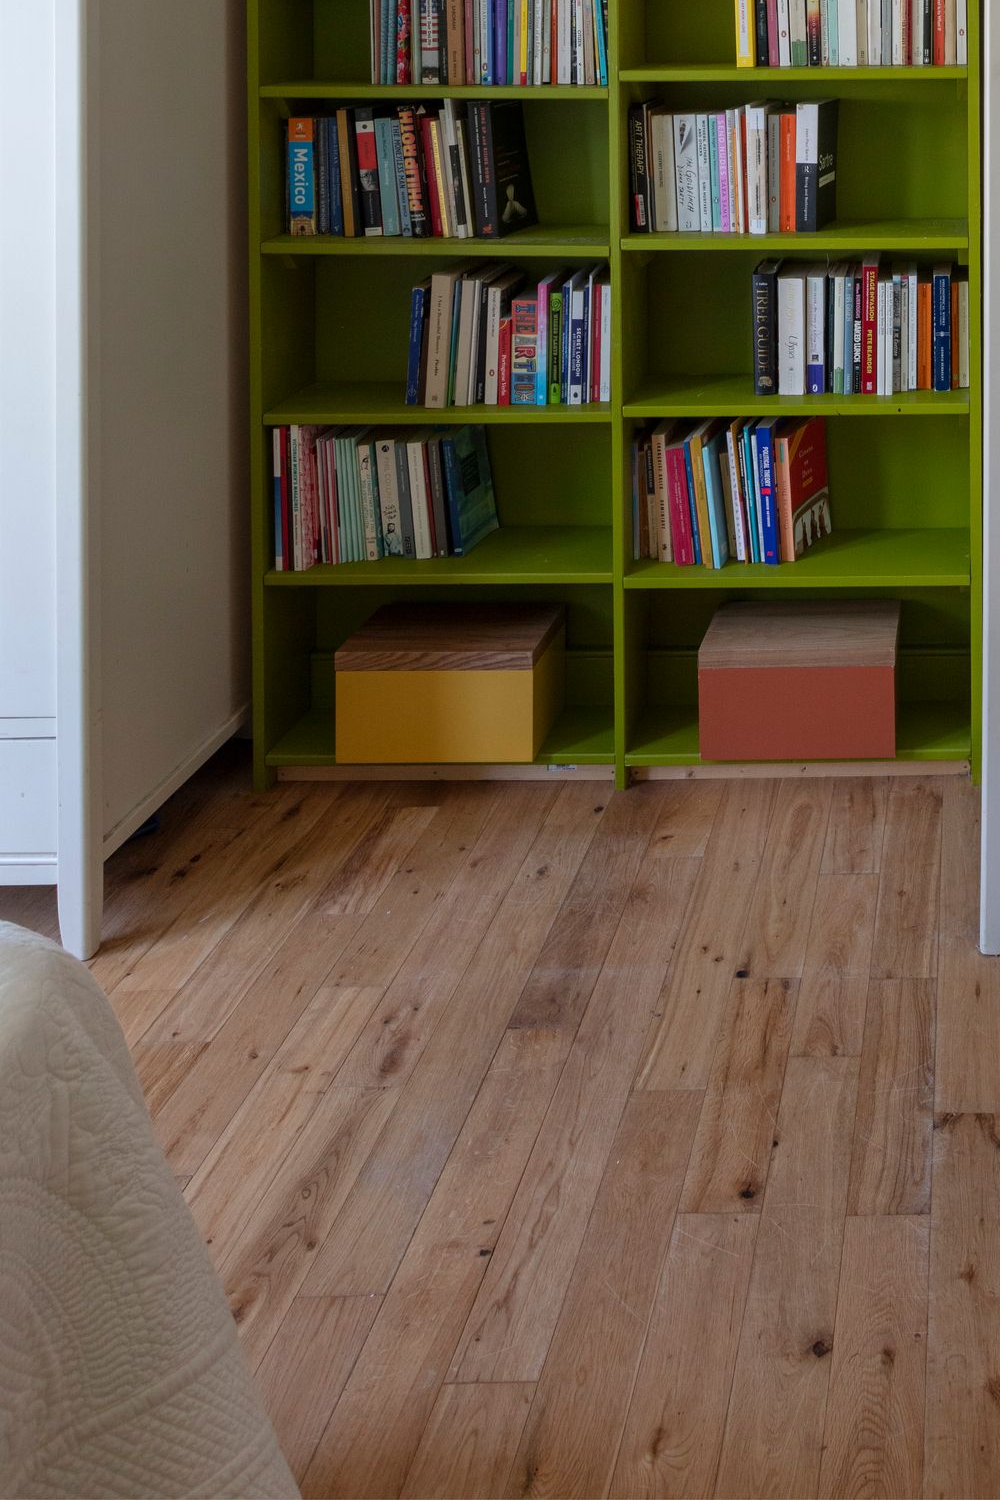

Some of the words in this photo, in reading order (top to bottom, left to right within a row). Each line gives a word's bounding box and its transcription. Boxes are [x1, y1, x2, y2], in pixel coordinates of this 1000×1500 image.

[394, 139, 404, 173] MONEYLESS
[398, 110, 417, 156] ROTH
[294, 148, 308, 204] Mexico
[636, 140, 644, 175] THERAPY
[405, 158, 424, 212] PHILIP
[756, 288, 769, 323] TREE
[757, 326, 770, 373] GUIDE
